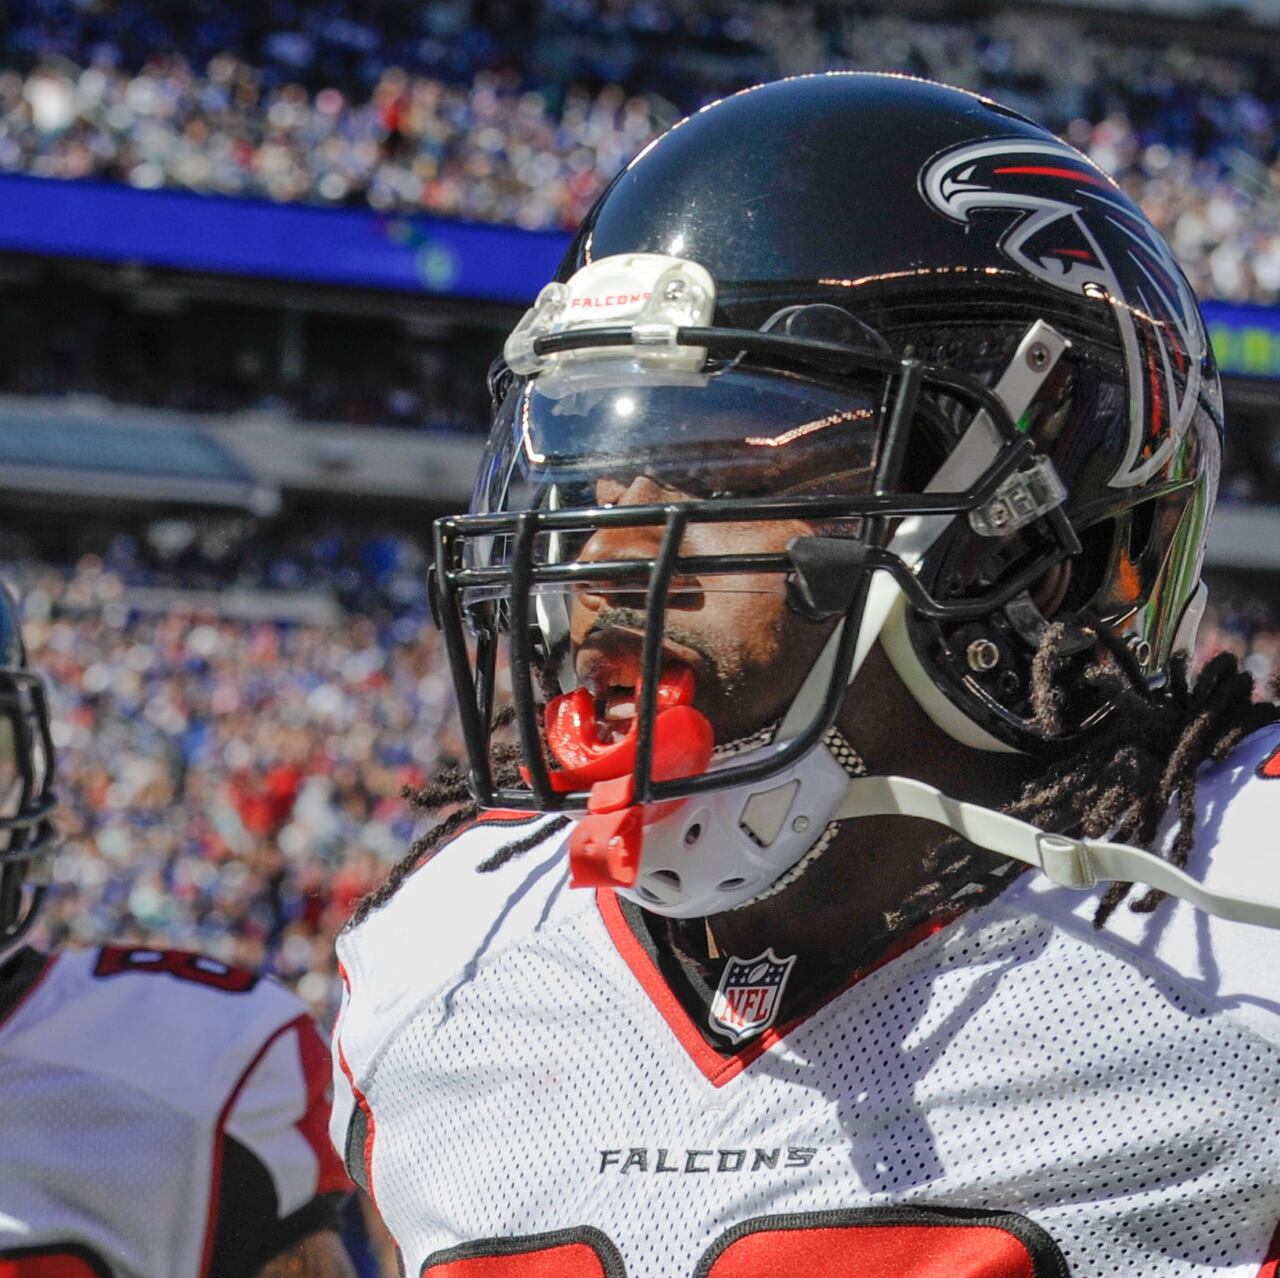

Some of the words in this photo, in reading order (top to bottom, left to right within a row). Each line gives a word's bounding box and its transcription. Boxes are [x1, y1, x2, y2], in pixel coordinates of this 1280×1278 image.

[571, 291, 652, 308] FALCONS
[719, 988, 770, 1027] NFL
[599, 1146, 818, 1174] FALCONS
